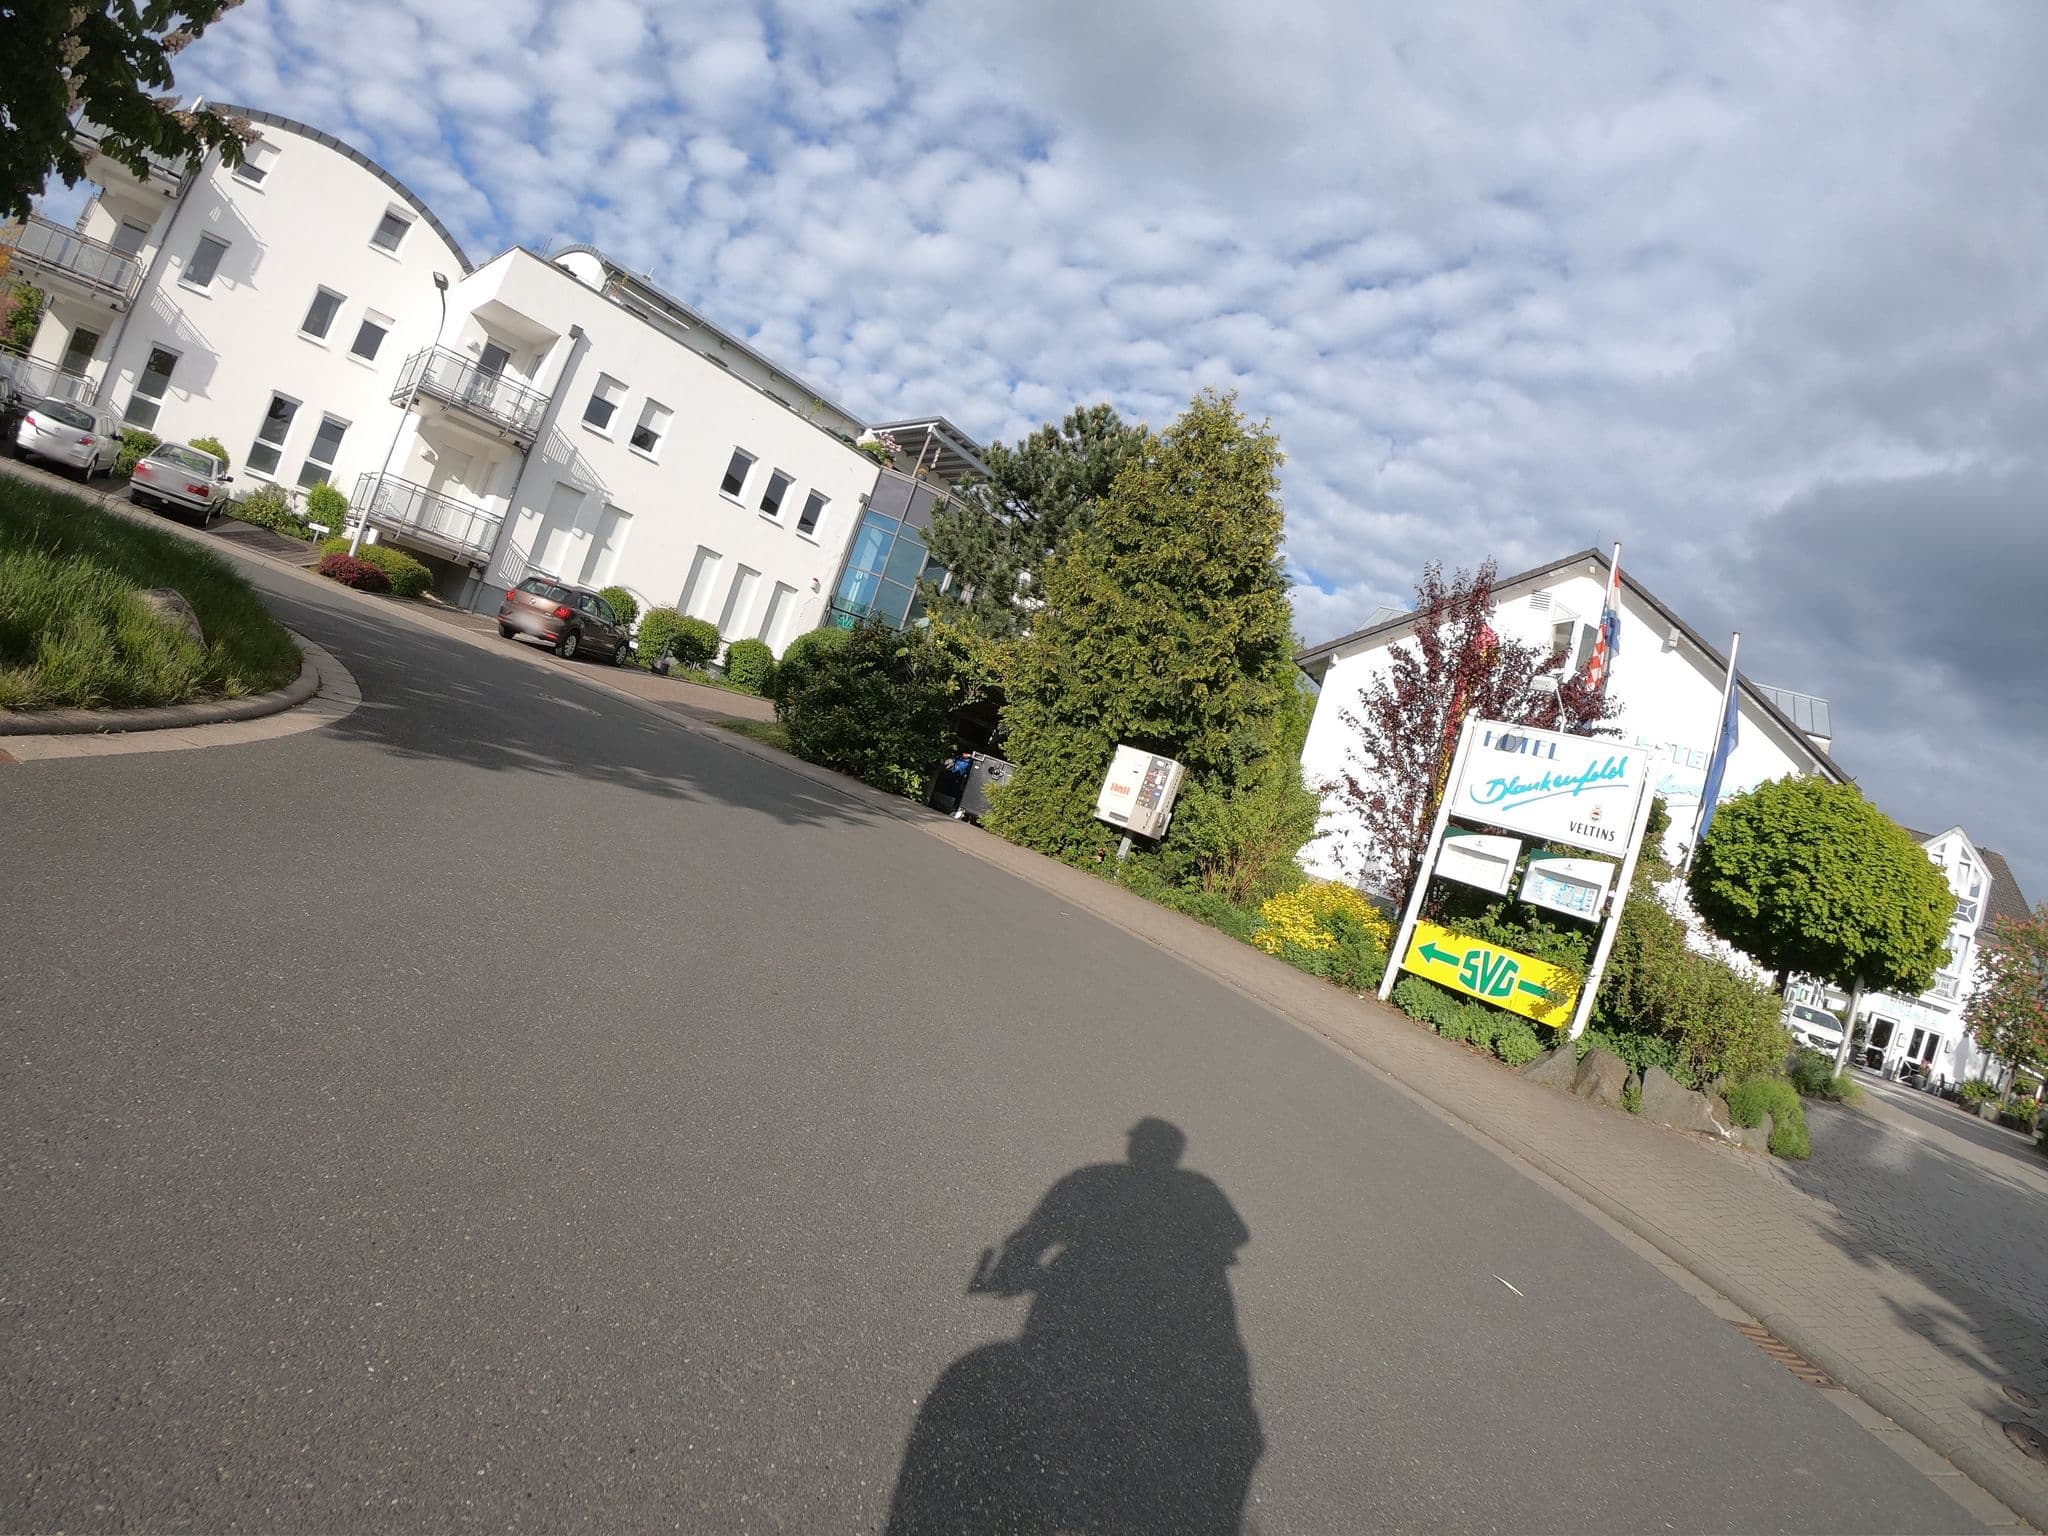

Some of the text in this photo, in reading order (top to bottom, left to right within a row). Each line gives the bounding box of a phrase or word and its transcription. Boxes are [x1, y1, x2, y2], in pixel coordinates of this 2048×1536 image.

[1472, 755, 1630, 804] Blankenfeld
[1570, 820, 1616, 842] VELTINS
[1459, 950, 1519, 996] SVG
